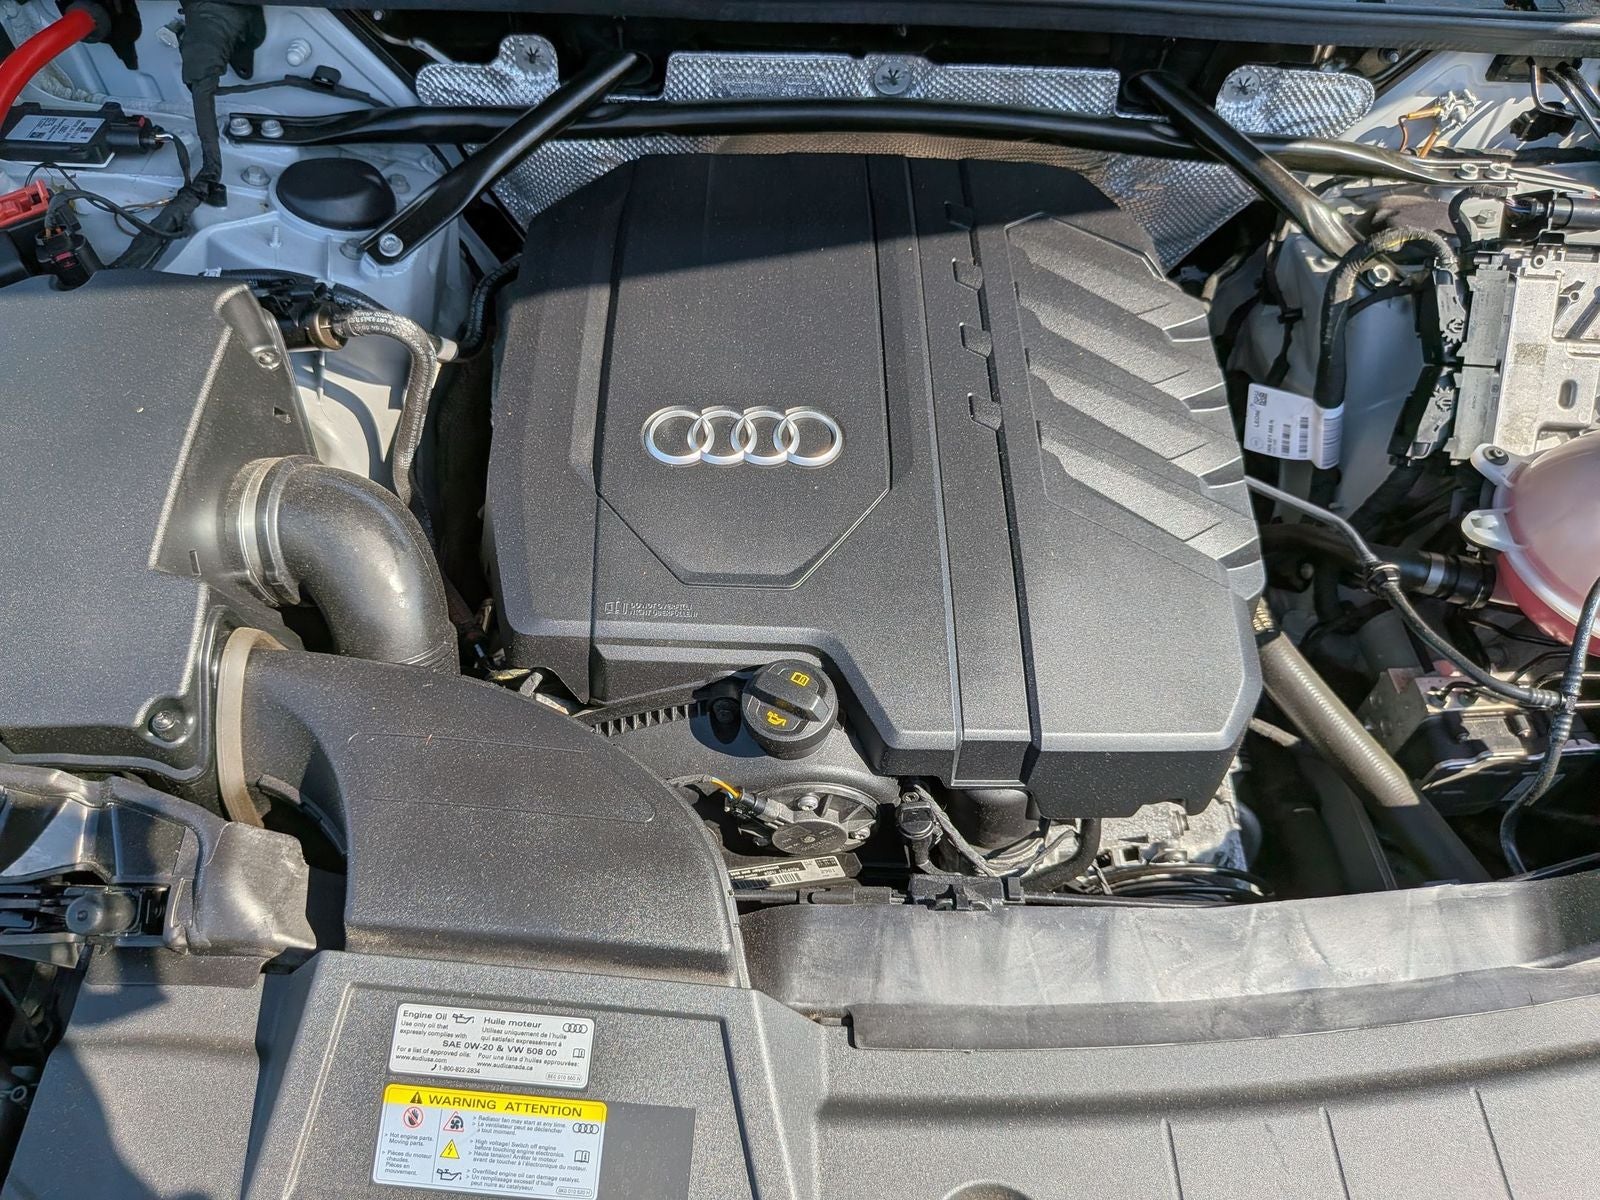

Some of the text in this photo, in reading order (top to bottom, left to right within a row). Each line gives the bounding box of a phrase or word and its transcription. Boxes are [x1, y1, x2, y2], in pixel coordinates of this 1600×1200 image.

[403, 1010, 432, 1019] Engine
[483, 1017, 542, 1028] Huile moteur
[427, 1030, 453, 1038] complies
[504, 1029, 539, 1038] uniquement
[442, 1040, 462, 1048] SAE
[464, 1041, 494, 1051] 0W-20
[507, 1045, 525, 1054] VW
[526, 1047, 544, 1055] 508
[429, 1095, 582, 1117] WARNING ATTENTION
